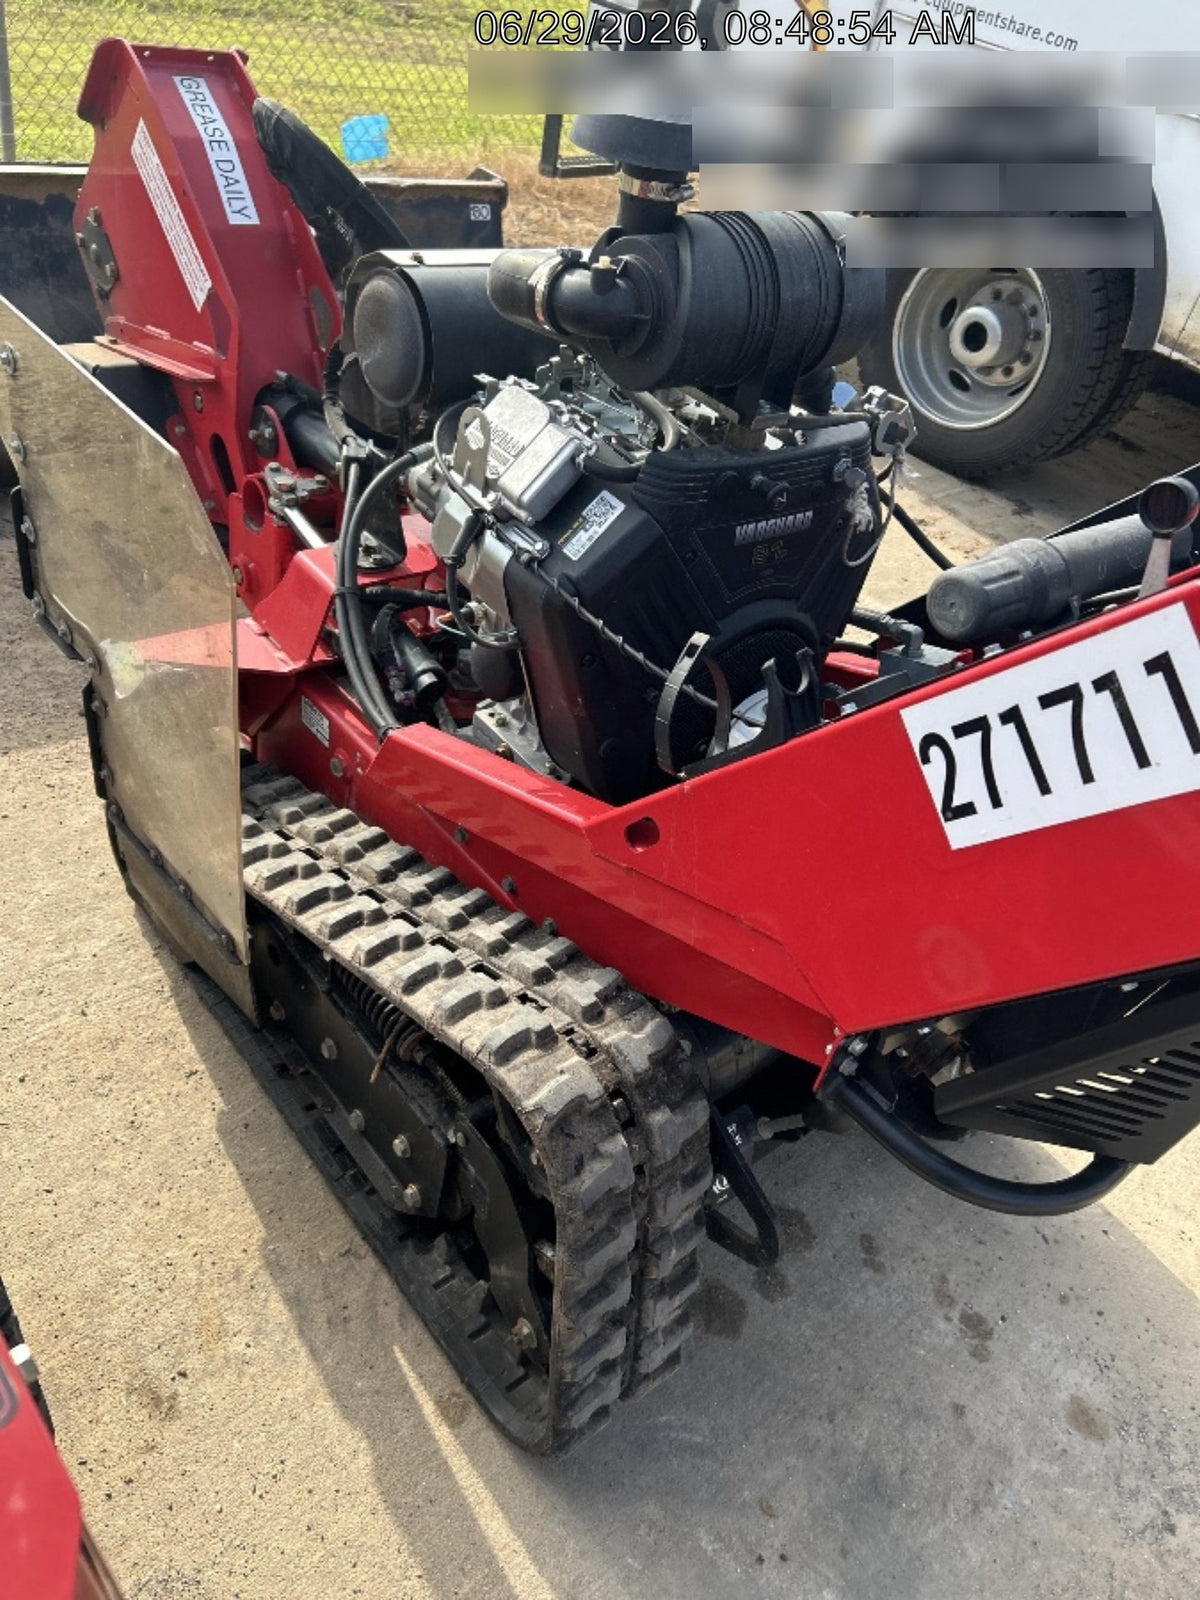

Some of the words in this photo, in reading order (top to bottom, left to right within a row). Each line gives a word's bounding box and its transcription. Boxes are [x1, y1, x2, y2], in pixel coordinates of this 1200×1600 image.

[180, 78, 230, 152] GREASE
[214, 159, 252, 220] DAILY
[919, 650, 1200, 822] 271711
